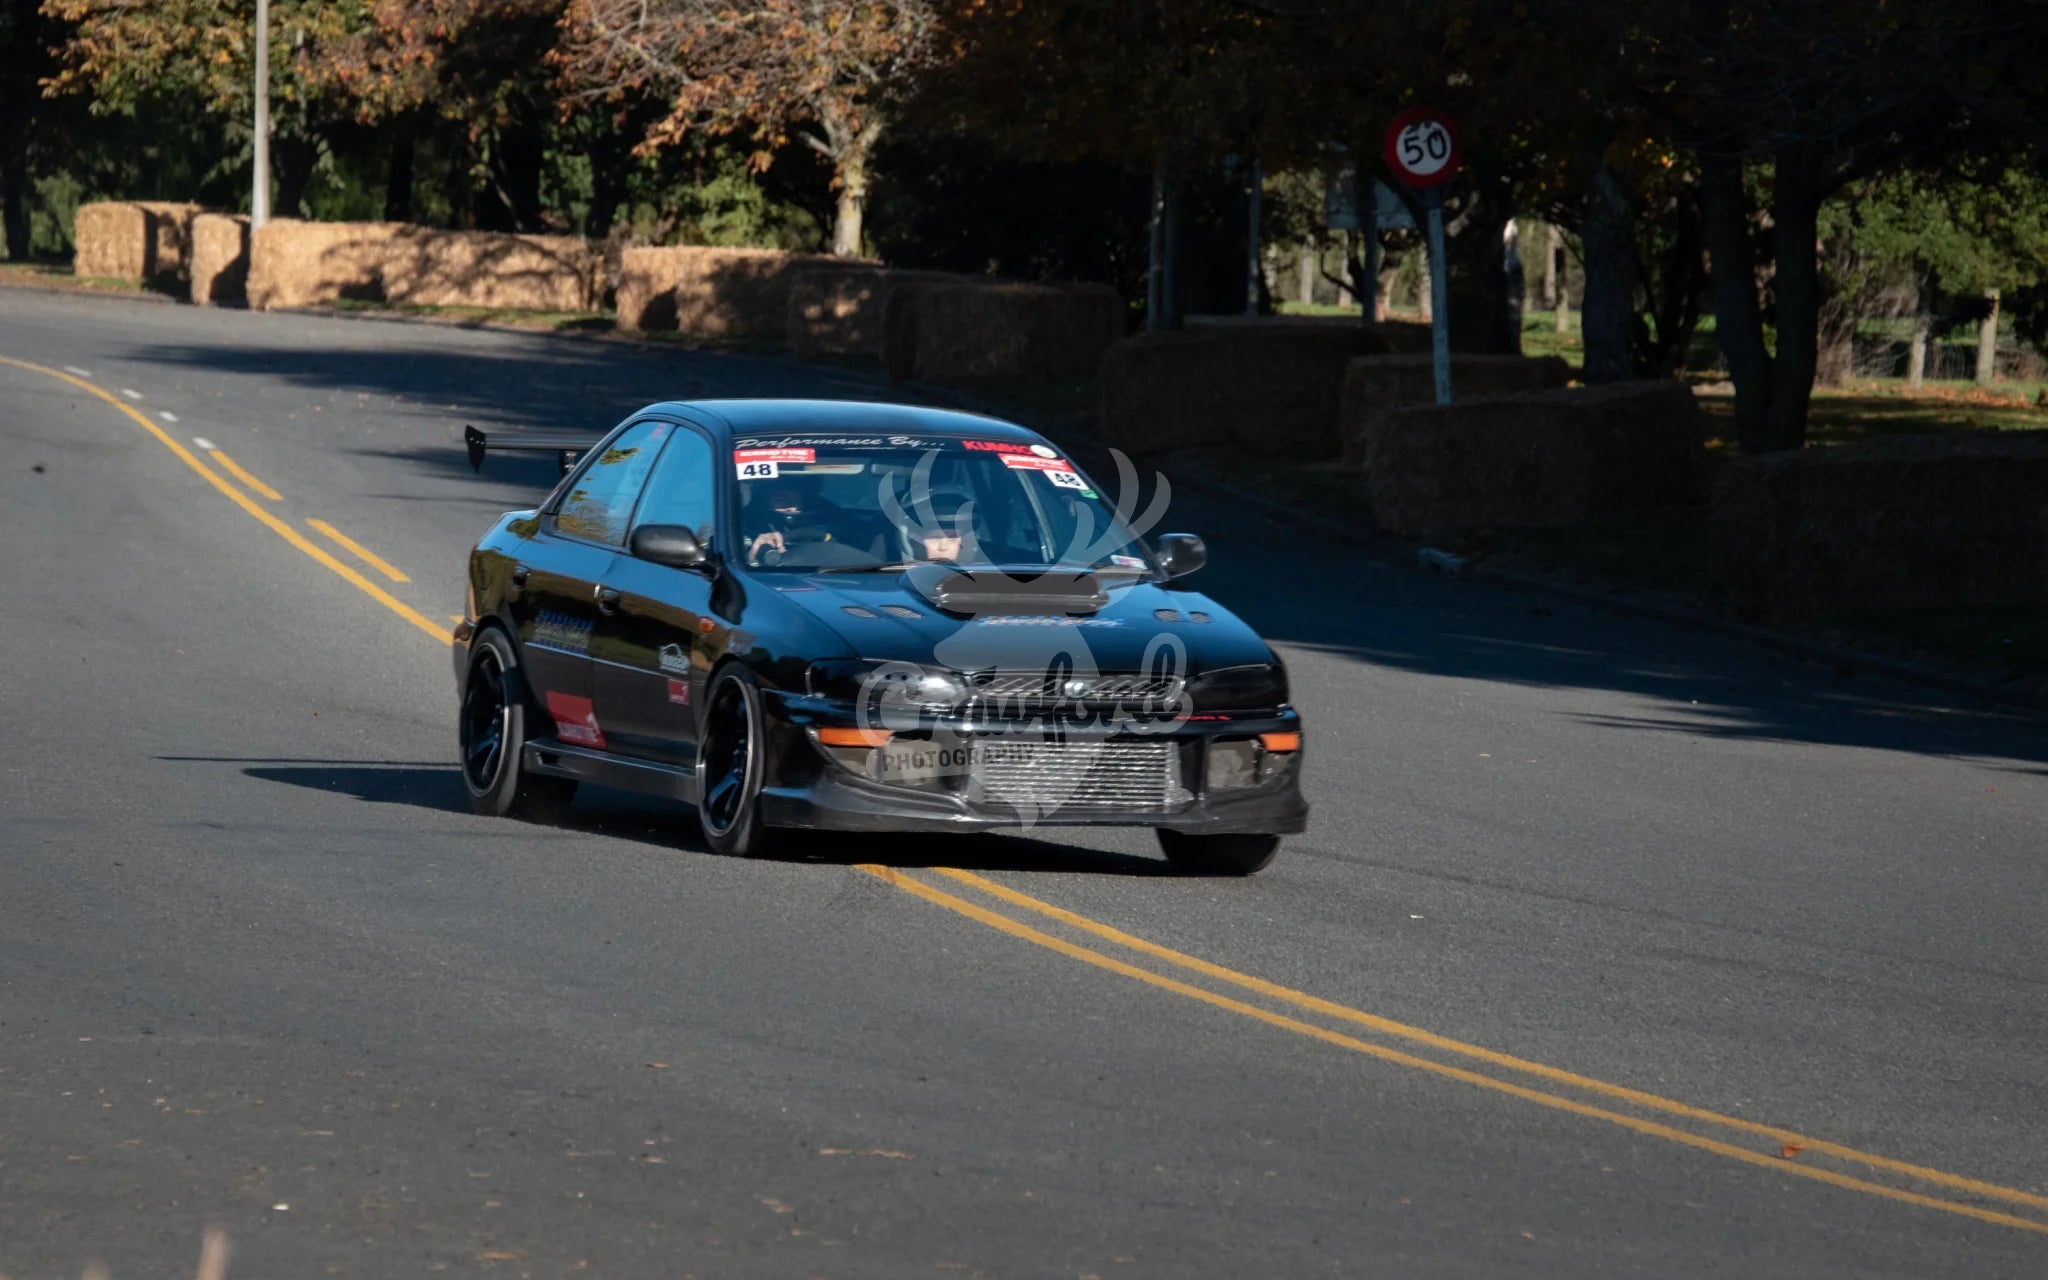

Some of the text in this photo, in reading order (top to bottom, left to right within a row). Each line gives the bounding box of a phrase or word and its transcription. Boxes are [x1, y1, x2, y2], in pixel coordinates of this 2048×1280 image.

[1404, 131, 1447, 165] 50
[735, 437, 882, 449] Performance
[743, 463, 772, 477] 48
